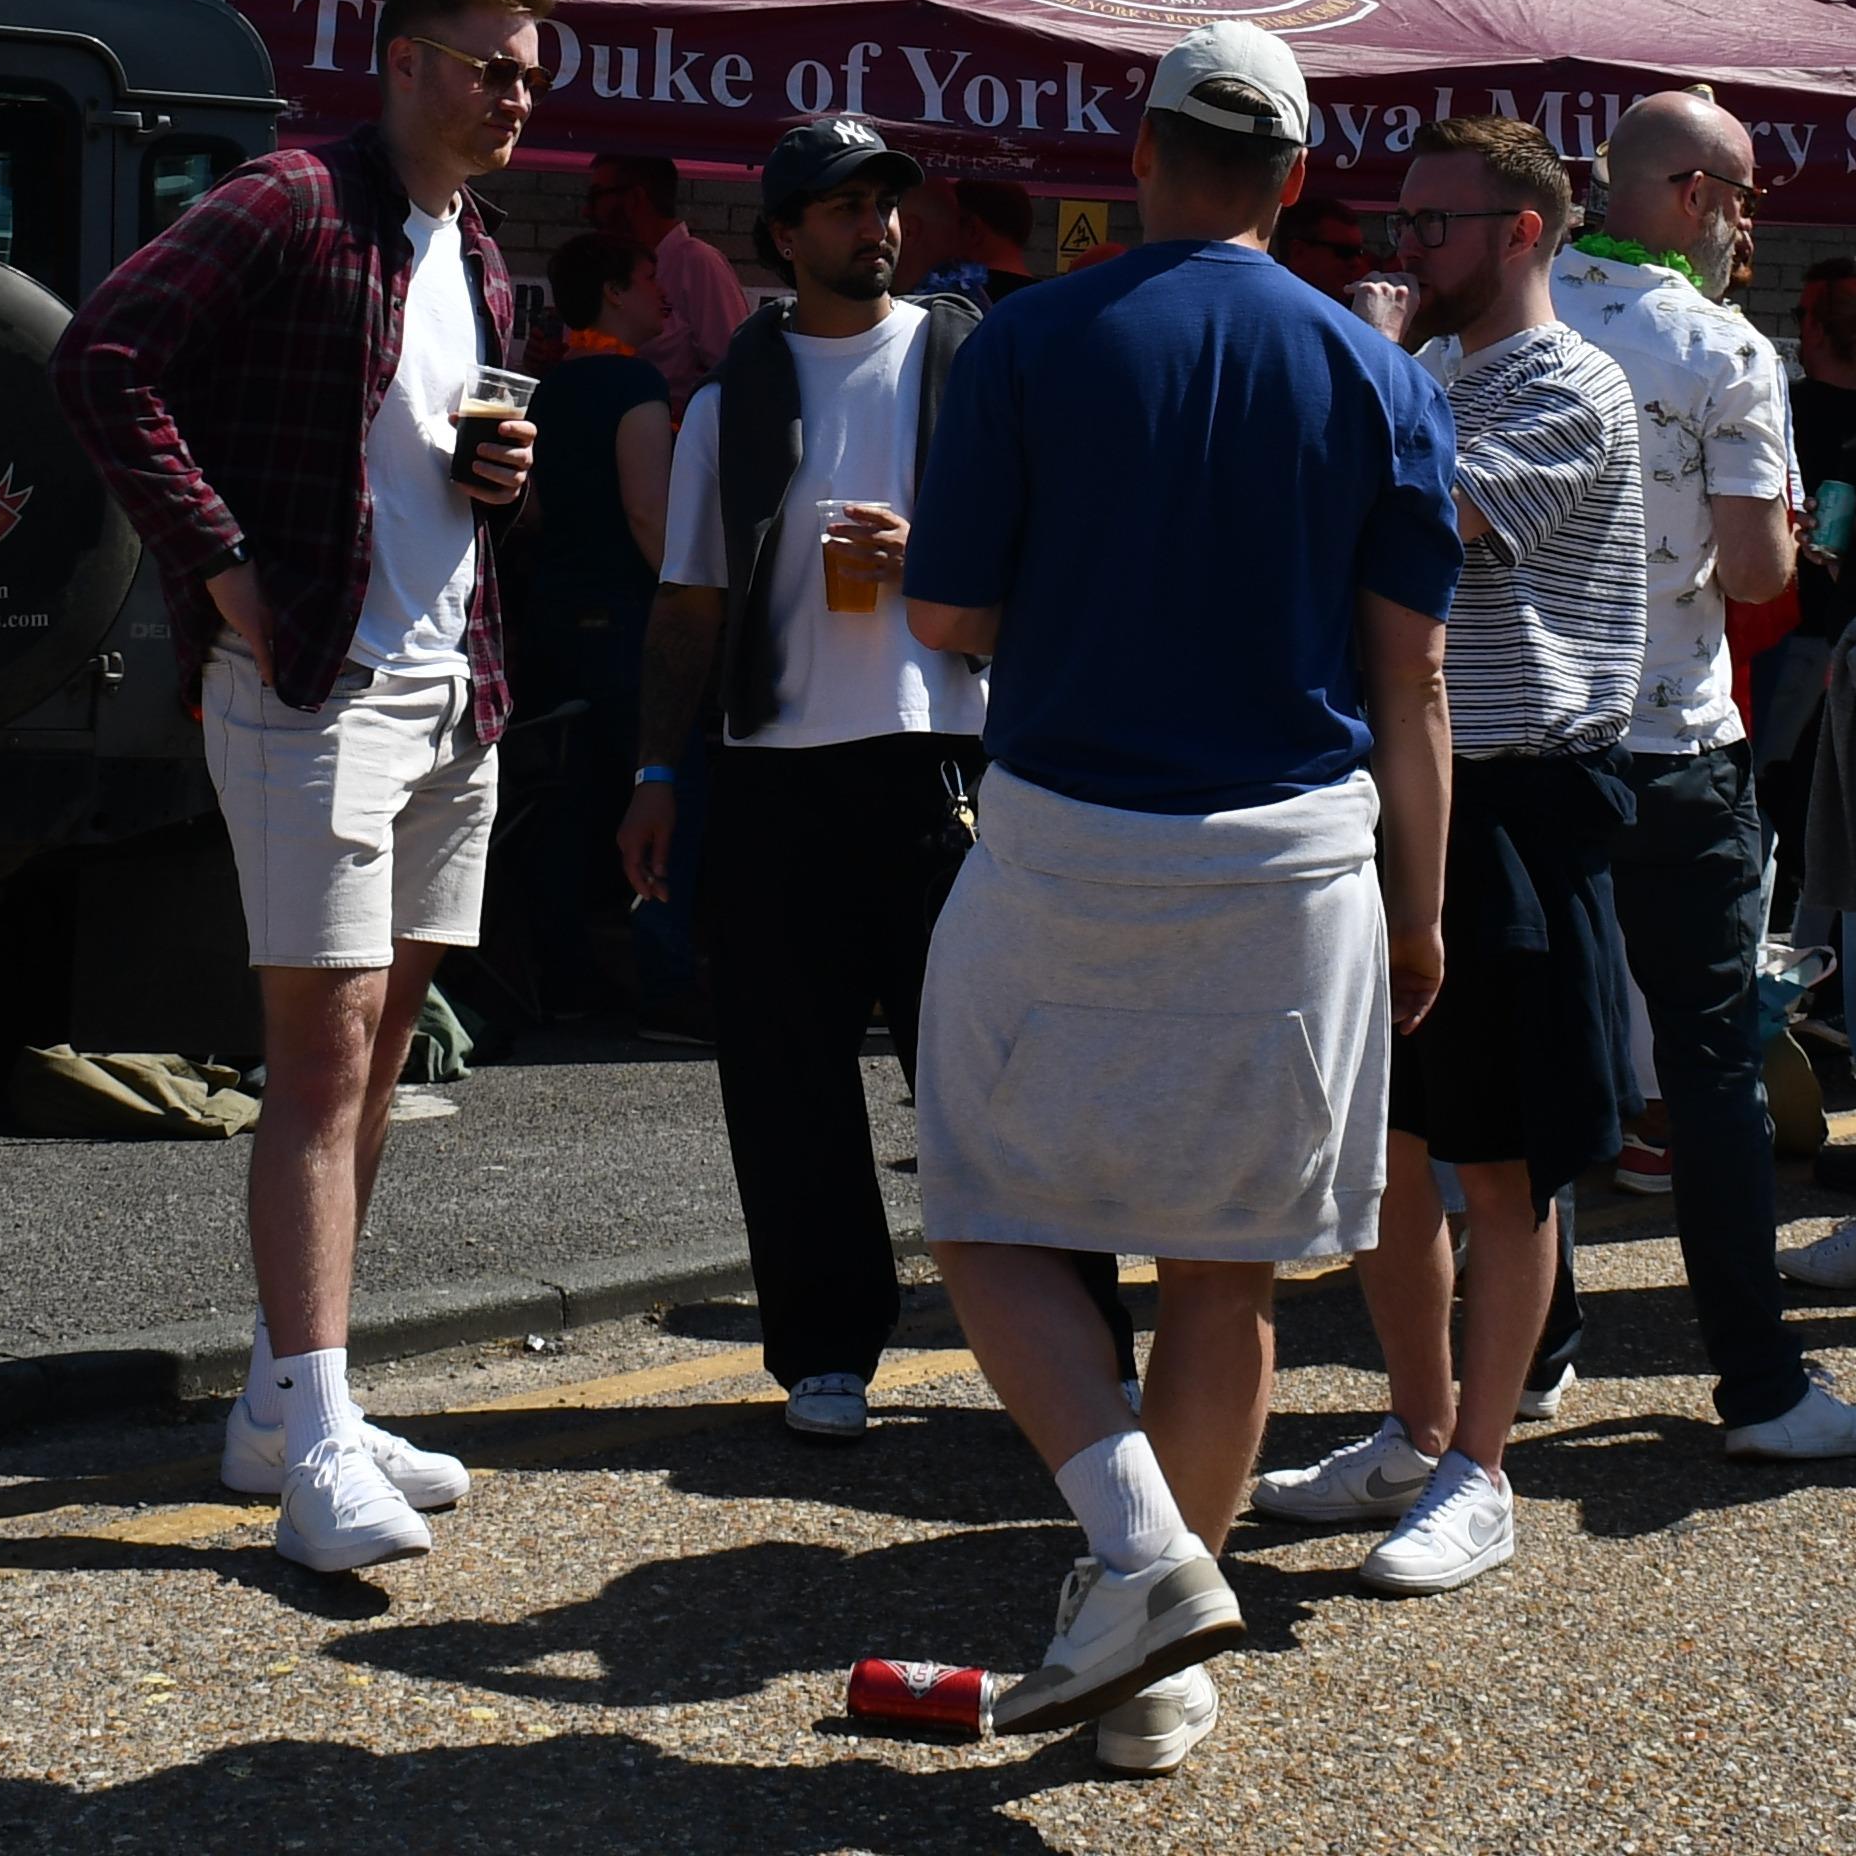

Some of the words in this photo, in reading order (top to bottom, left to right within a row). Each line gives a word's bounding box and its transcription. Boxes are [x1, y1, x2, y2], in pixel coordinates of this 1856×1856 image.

[1087, 0, 1162, 22] YORK'S
[785, 41, 882, 117] of
[897, 46, 1145, 136] York'
[1306, 86, 1454, 170] oyal
